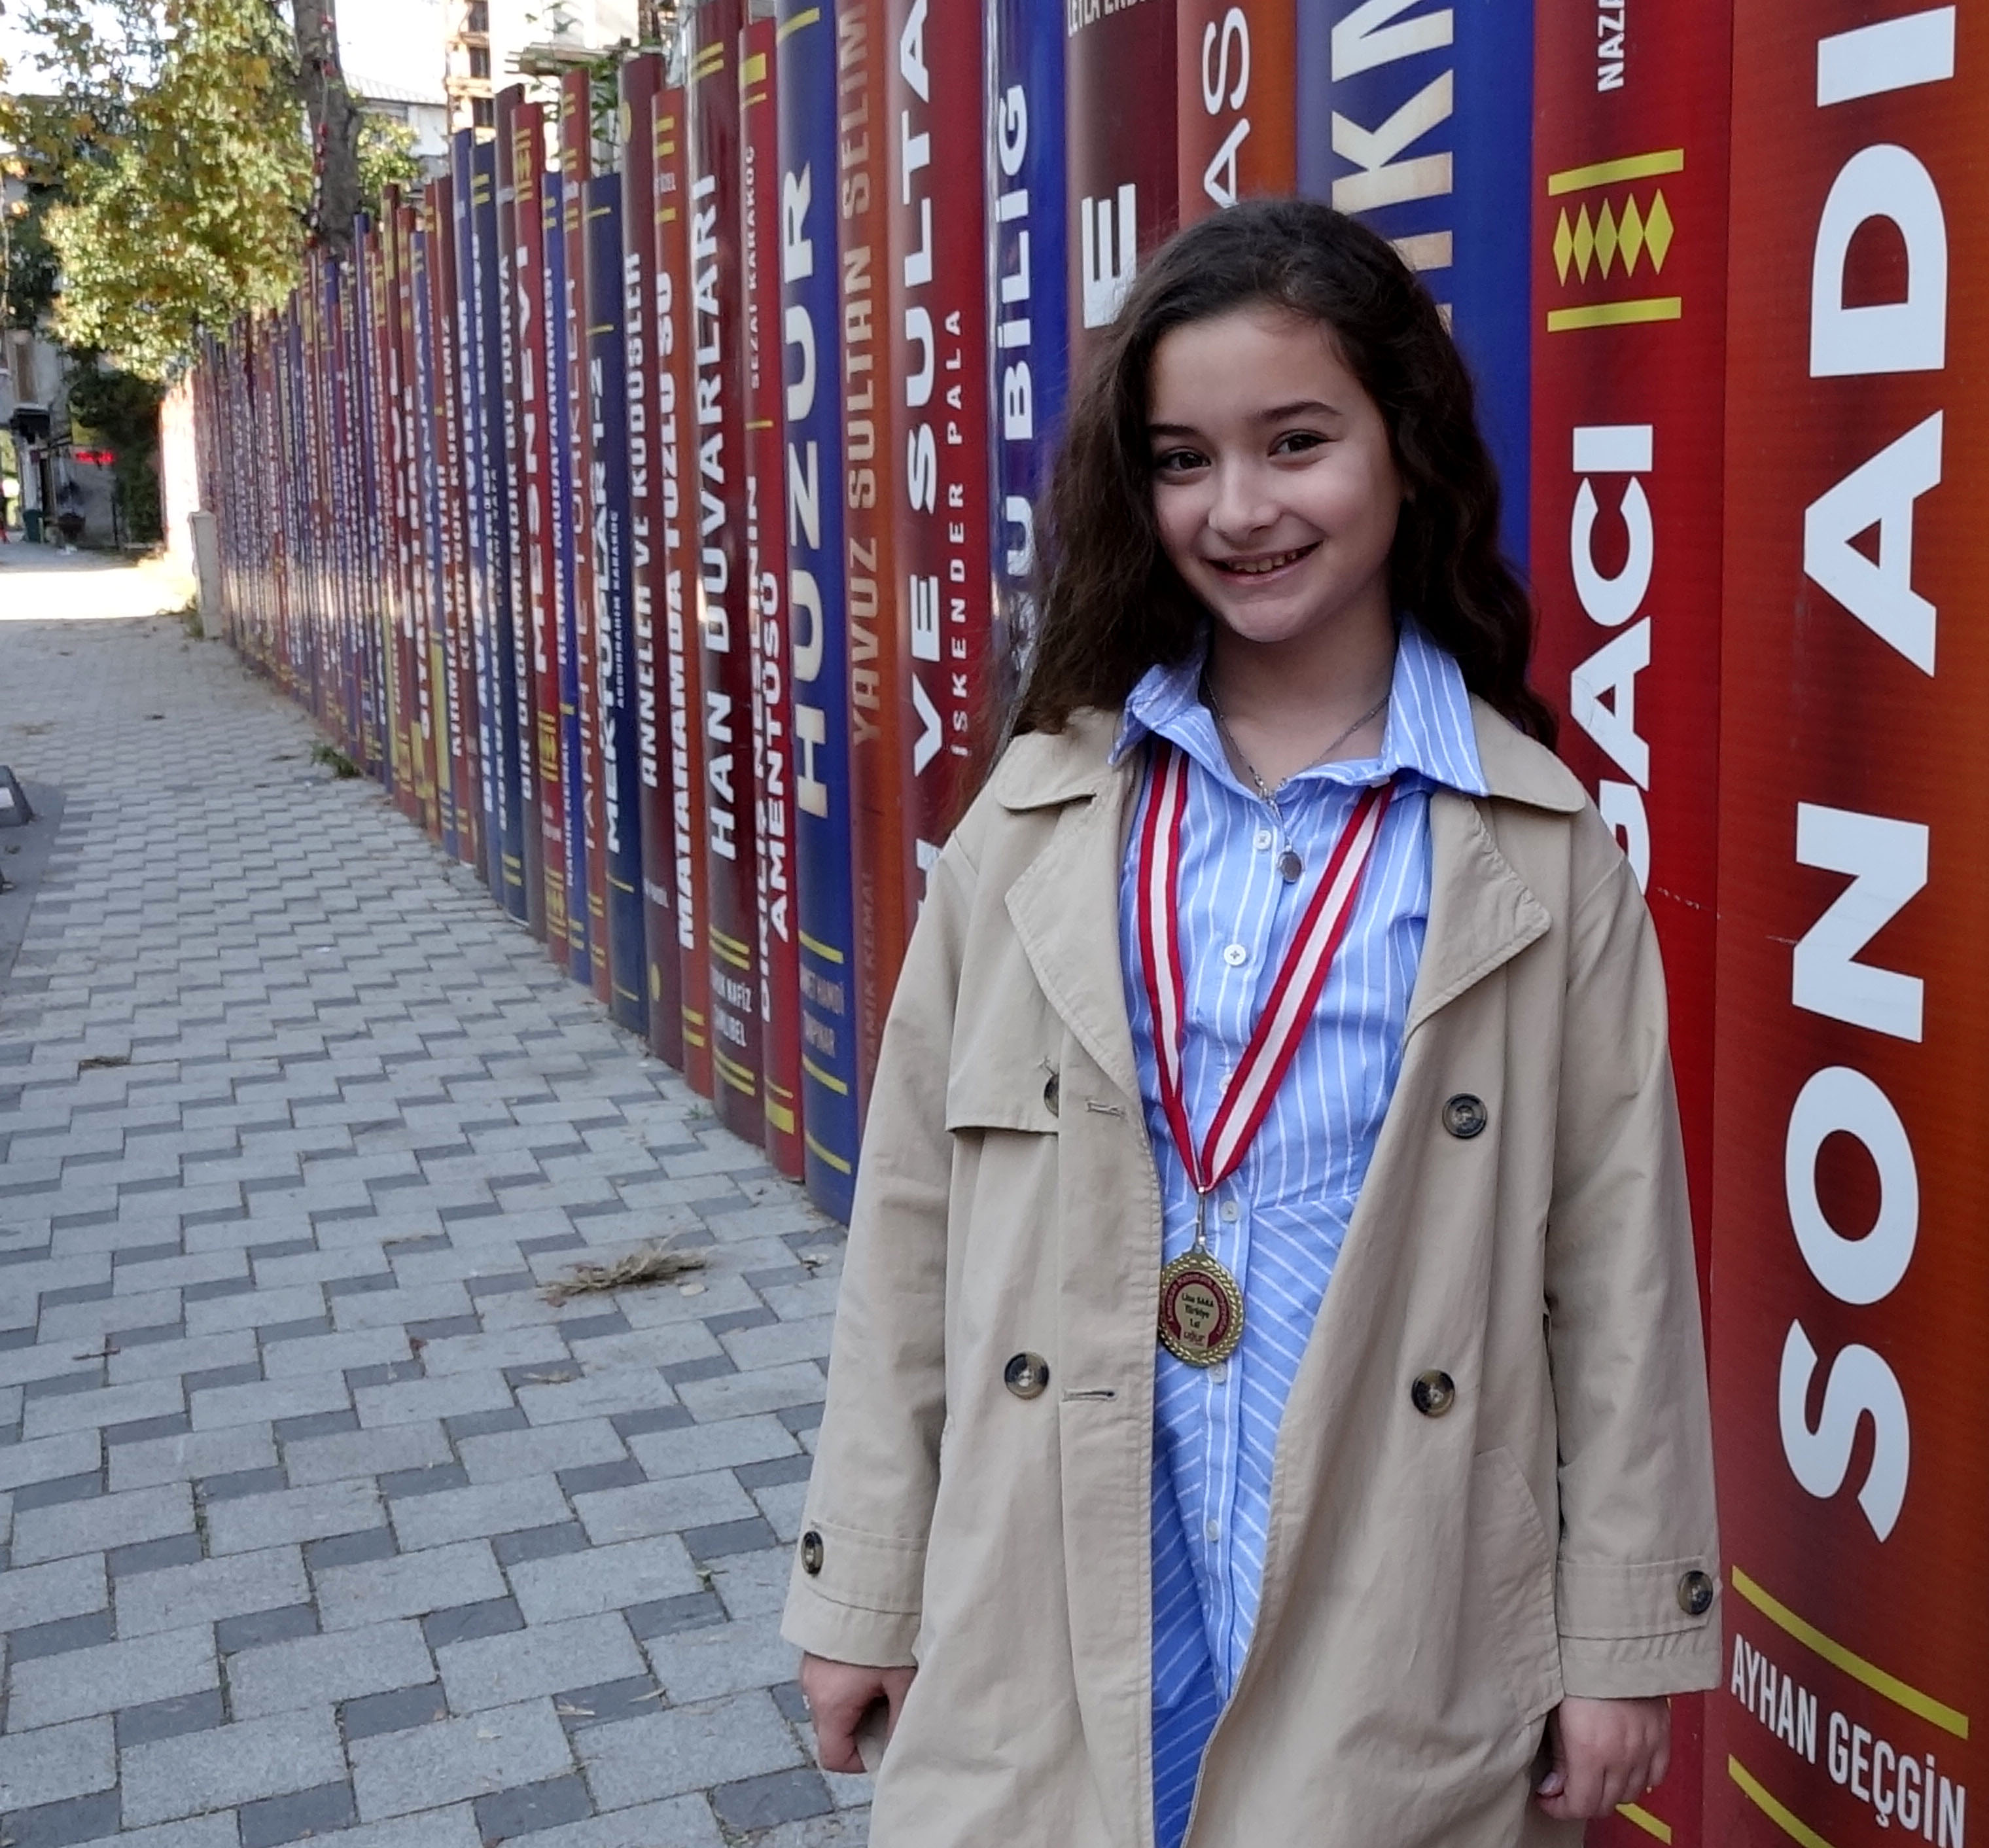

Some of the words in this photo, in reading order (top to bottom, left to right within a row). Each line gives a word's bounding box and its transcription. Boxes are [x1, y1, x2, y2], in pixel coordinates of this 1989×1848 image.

[656, 272, 674, 357] SU
[843, 246, 876, 510] SULTAN
[945, 311, 962, 446] PALA
[995, 84, 1032, 440] BİLİG
[660, 372, 680, 555] TUZLU
[692, 175, 730, 652] DUVARLARI
[783, 162, 828, 819] HUZUR
[593, 461, 620, 854] MEKTUPLAR
[633, 514, 650, 568] VE
[849, 536, 881, 748] YAVUZ
[947, 483, 969, 757] İSKENDER
[634, 584, 658, 789] ANNELER
[666, 569, 694, 950] MATARAMDA
[707, 690, 735, 861] HAN
[761, 572, 788, 943] AMENTÜSÜ
[909, 575, 943, 777] VE
[1778, 801, 1929, 1543] SON
[1731, 1633, 1817, 1765] AYHAN
[1828, 1711, 1965, 1848] GEÇGİN
